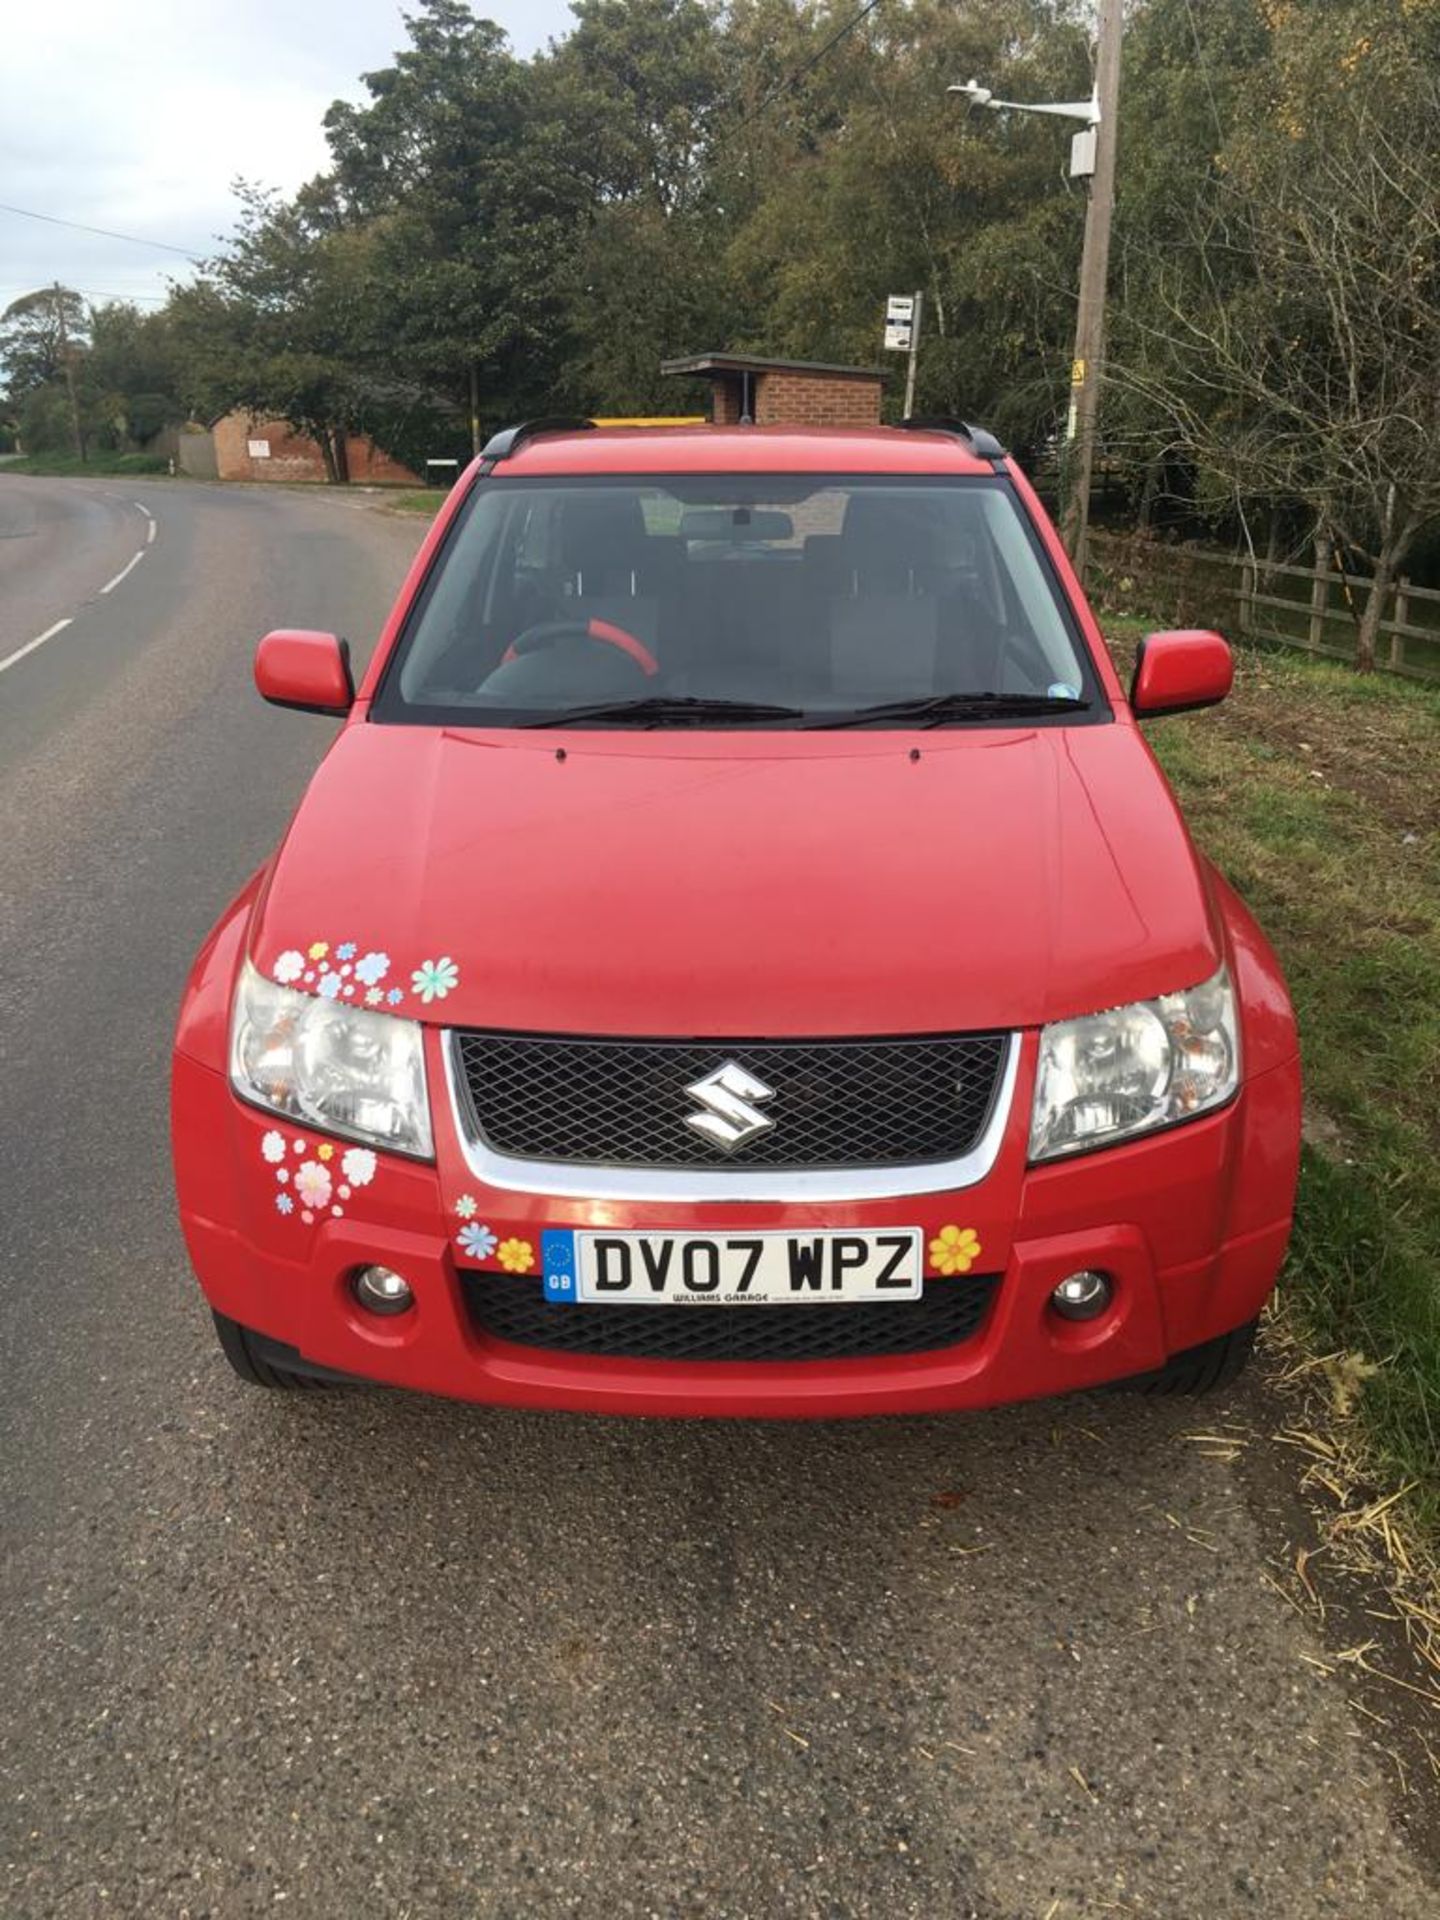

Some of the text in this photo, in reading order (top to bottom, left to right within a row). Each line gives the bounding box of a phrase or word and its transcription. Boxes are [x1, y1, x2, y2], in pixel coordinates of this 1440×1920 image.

[594, 1235, 913, 1292] DV07 WPZ
[548, 1275, 571, 1290] GB
[672, 1293, 721, 1302] WILLIAMS
[724, 1293, 769, 1302] GARAGE
